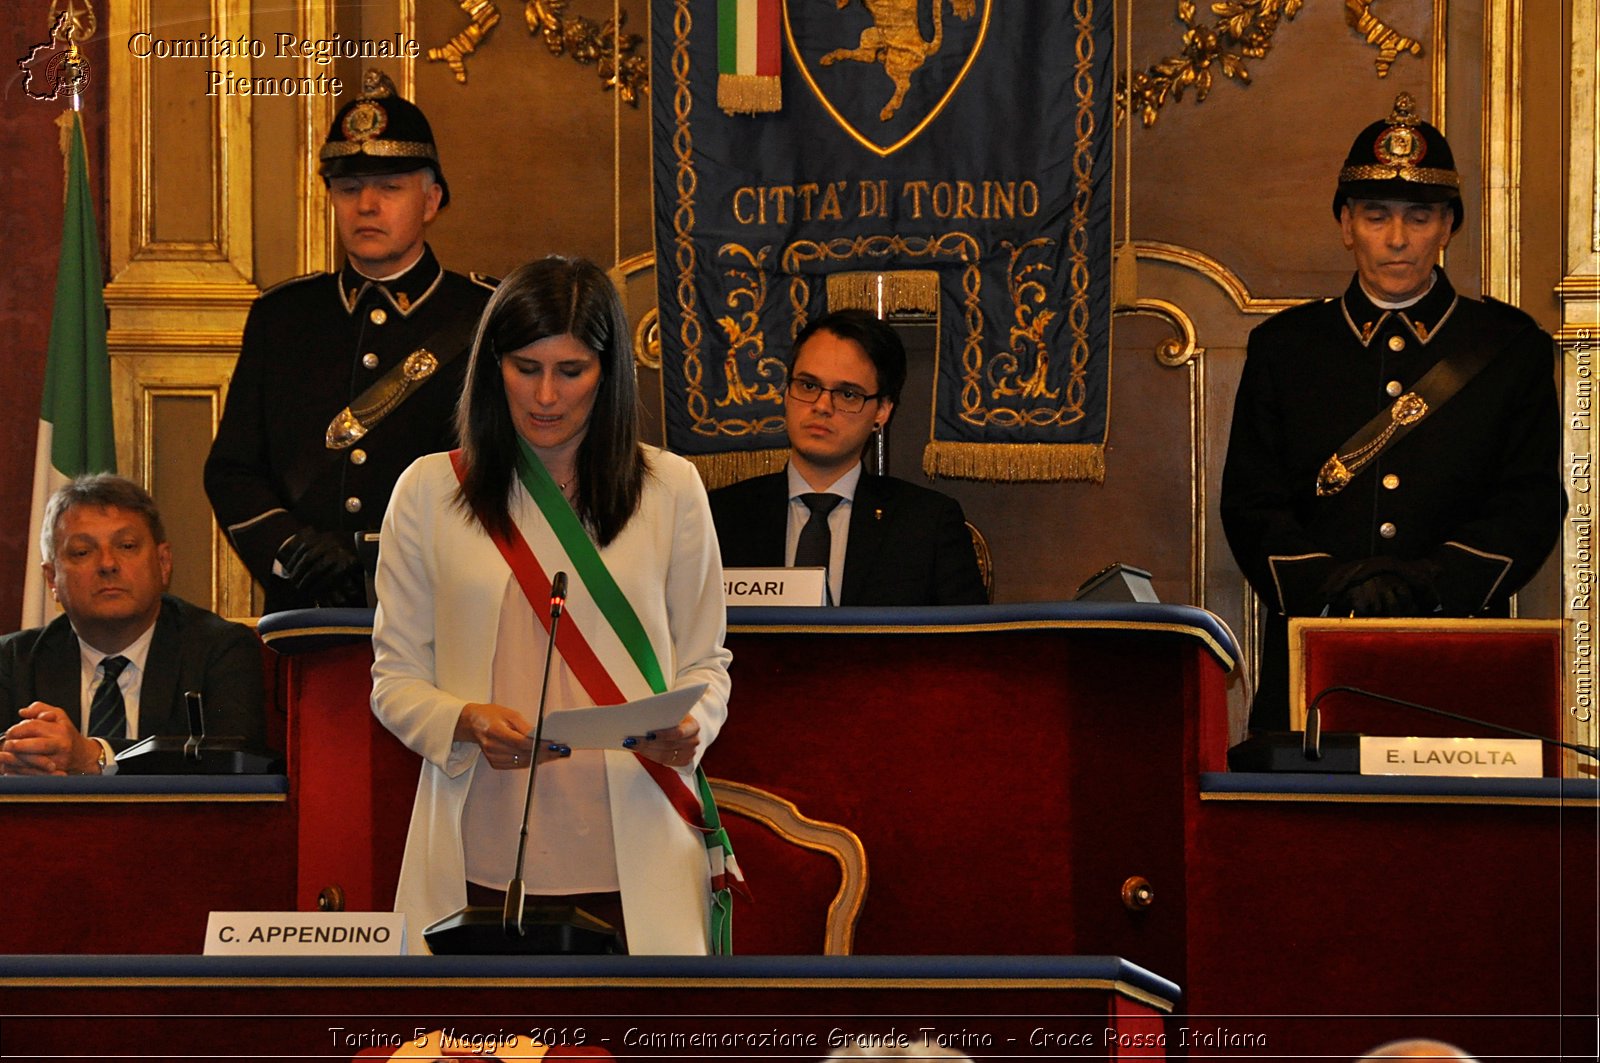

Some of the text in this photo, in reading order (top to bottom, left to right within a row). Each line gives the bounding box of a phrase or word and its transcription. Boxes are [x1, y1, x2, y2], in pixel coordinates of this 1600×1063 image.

[858, 180, 889, 217] DI
[903, 180, 1040, 219] TORINO
[1386, 749, 1517, 765] E. LAVOLTA
[218, 926, 391, 943] C. APPENDINO
